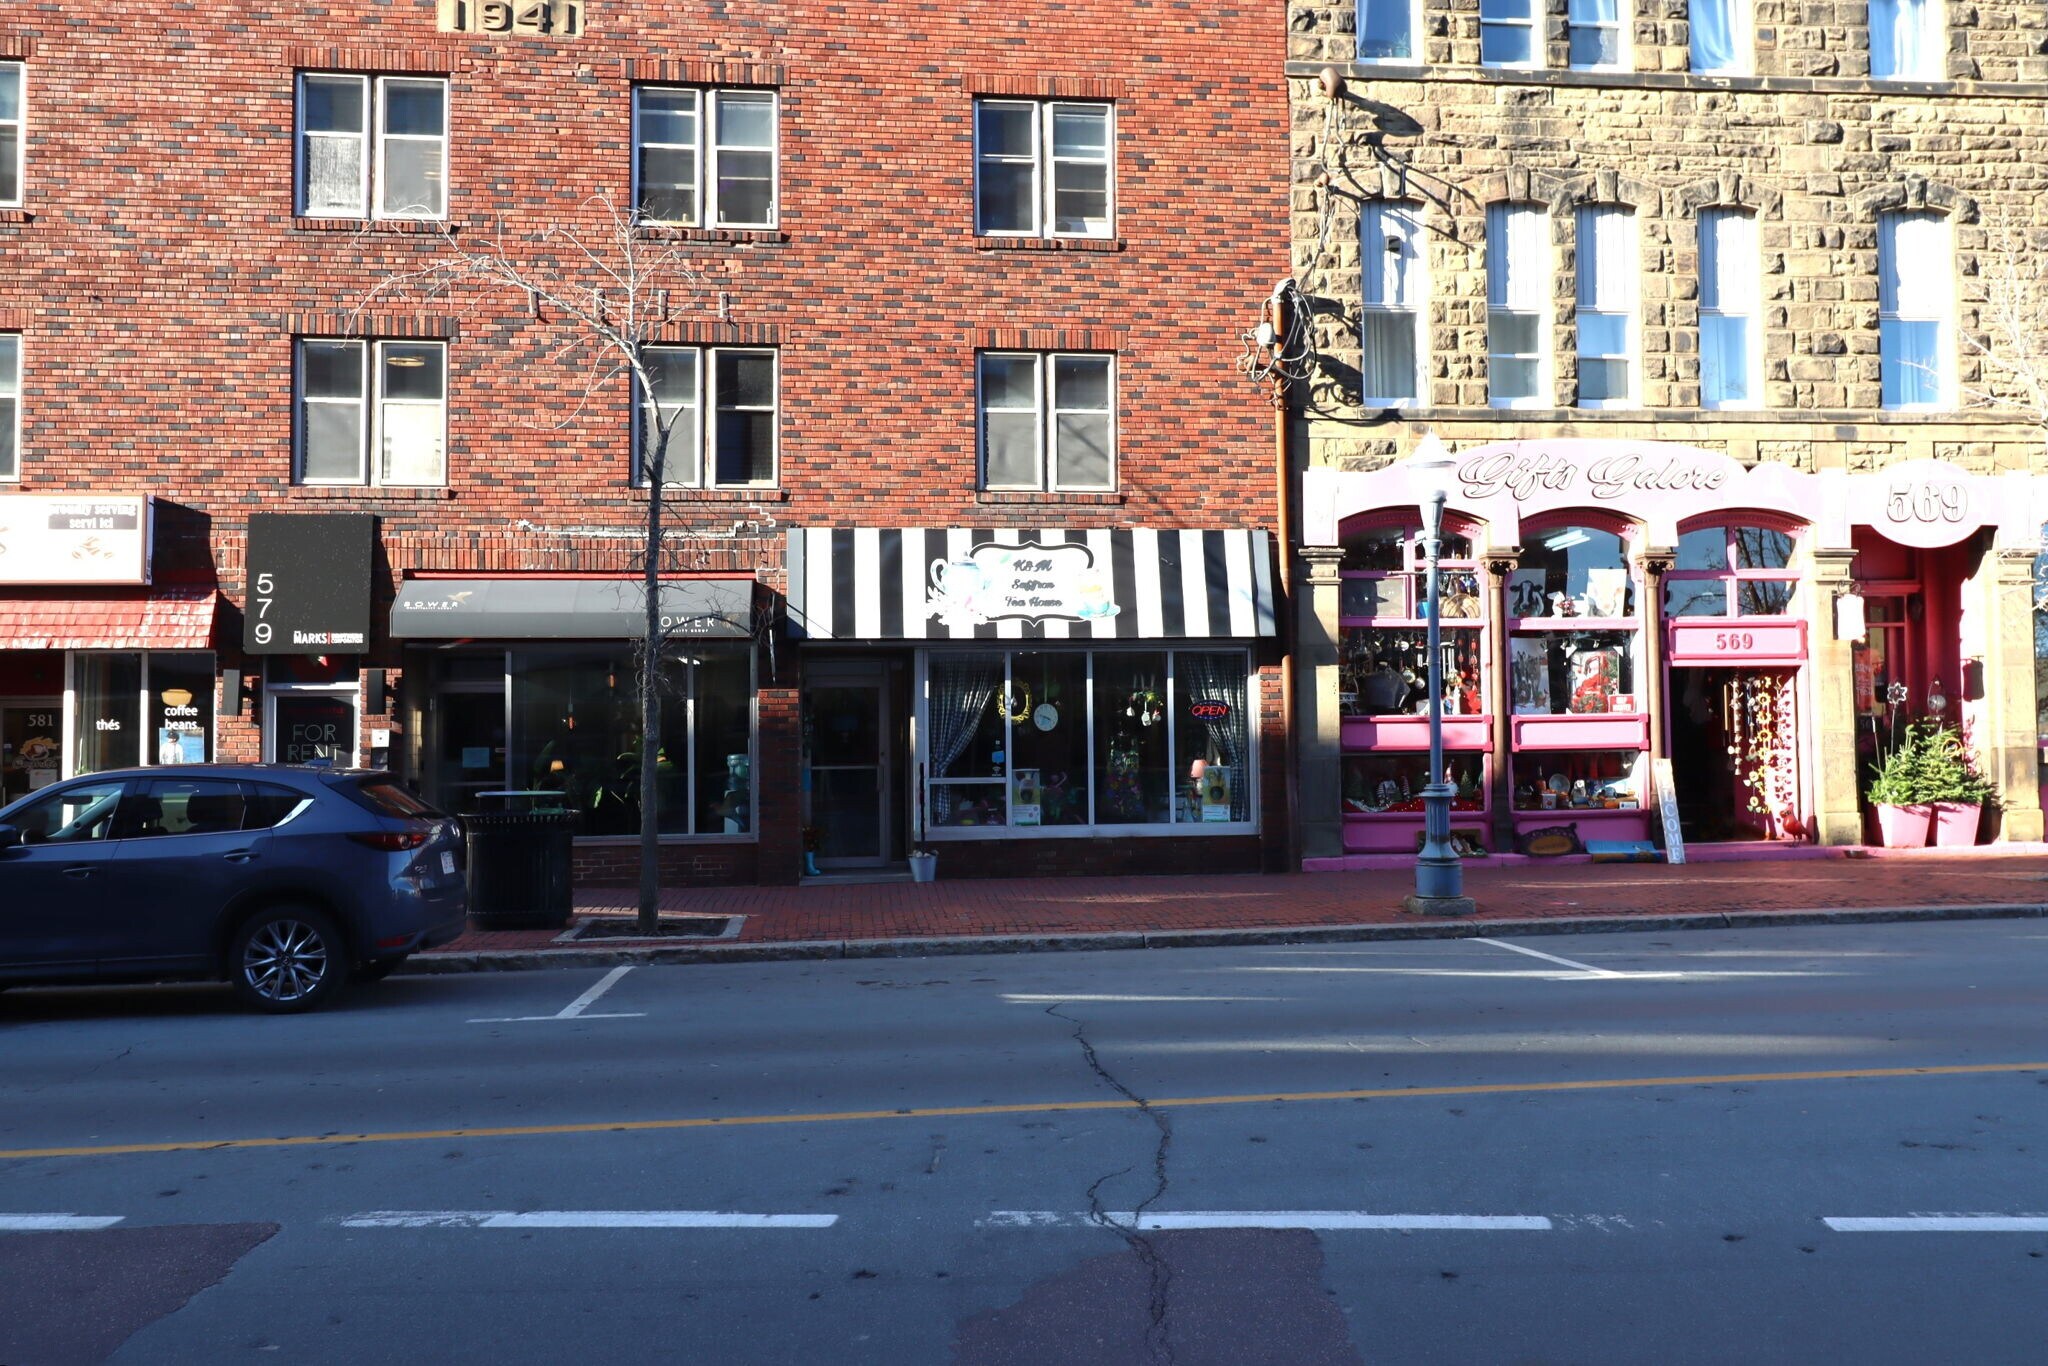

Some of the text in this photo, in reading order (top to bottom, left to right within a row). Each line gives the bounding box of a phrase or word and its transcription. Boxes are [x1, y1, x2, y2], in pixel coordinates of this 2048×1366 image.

[453, 0, 576, 34] 1941
[1458, 452, 1729, 501] Gifts Galore
[1887, 481, 1968, 523] 569
[660, 616, 715, 628] OWER
[293, 630, 328, 644] MARKS
[1716, 633, 1753, 650] 569
[164, 705, 198, 717] coffee
[1191, 705, 1227, 716] OPEN
[27, 714, 53, 727] 581
[96, 719, 120, 731] thés
[164, 719, 198, 730] beans
[292, 723, 336, 742] FOR
[287, 743, 342, 761] RENT
